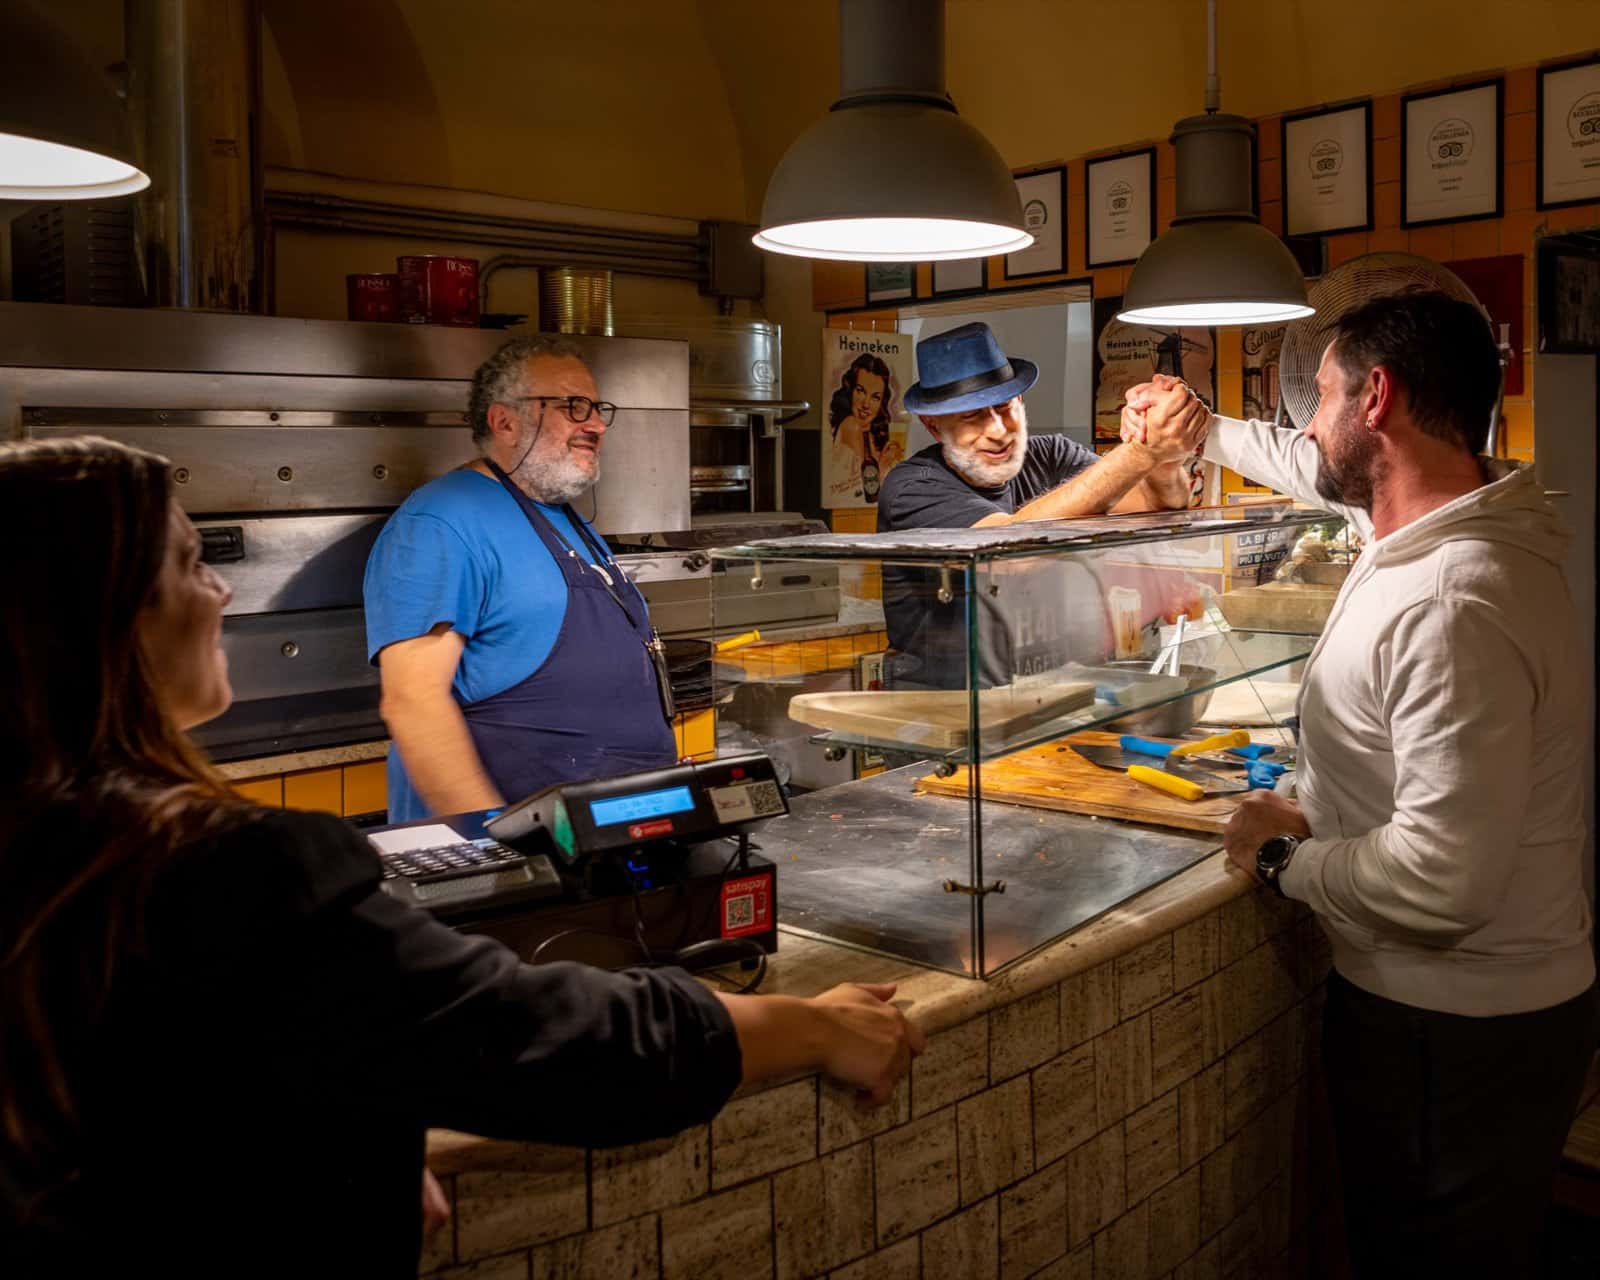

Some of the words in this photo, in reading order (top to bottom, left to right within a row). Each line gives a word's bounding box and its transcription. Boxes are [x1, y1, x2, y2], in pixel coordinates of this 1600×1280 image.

[839, 335, 899, 354] Heineken
[1106, 338, 1150, 350] Heineken
[1239, 536, 1252, 546] LA
